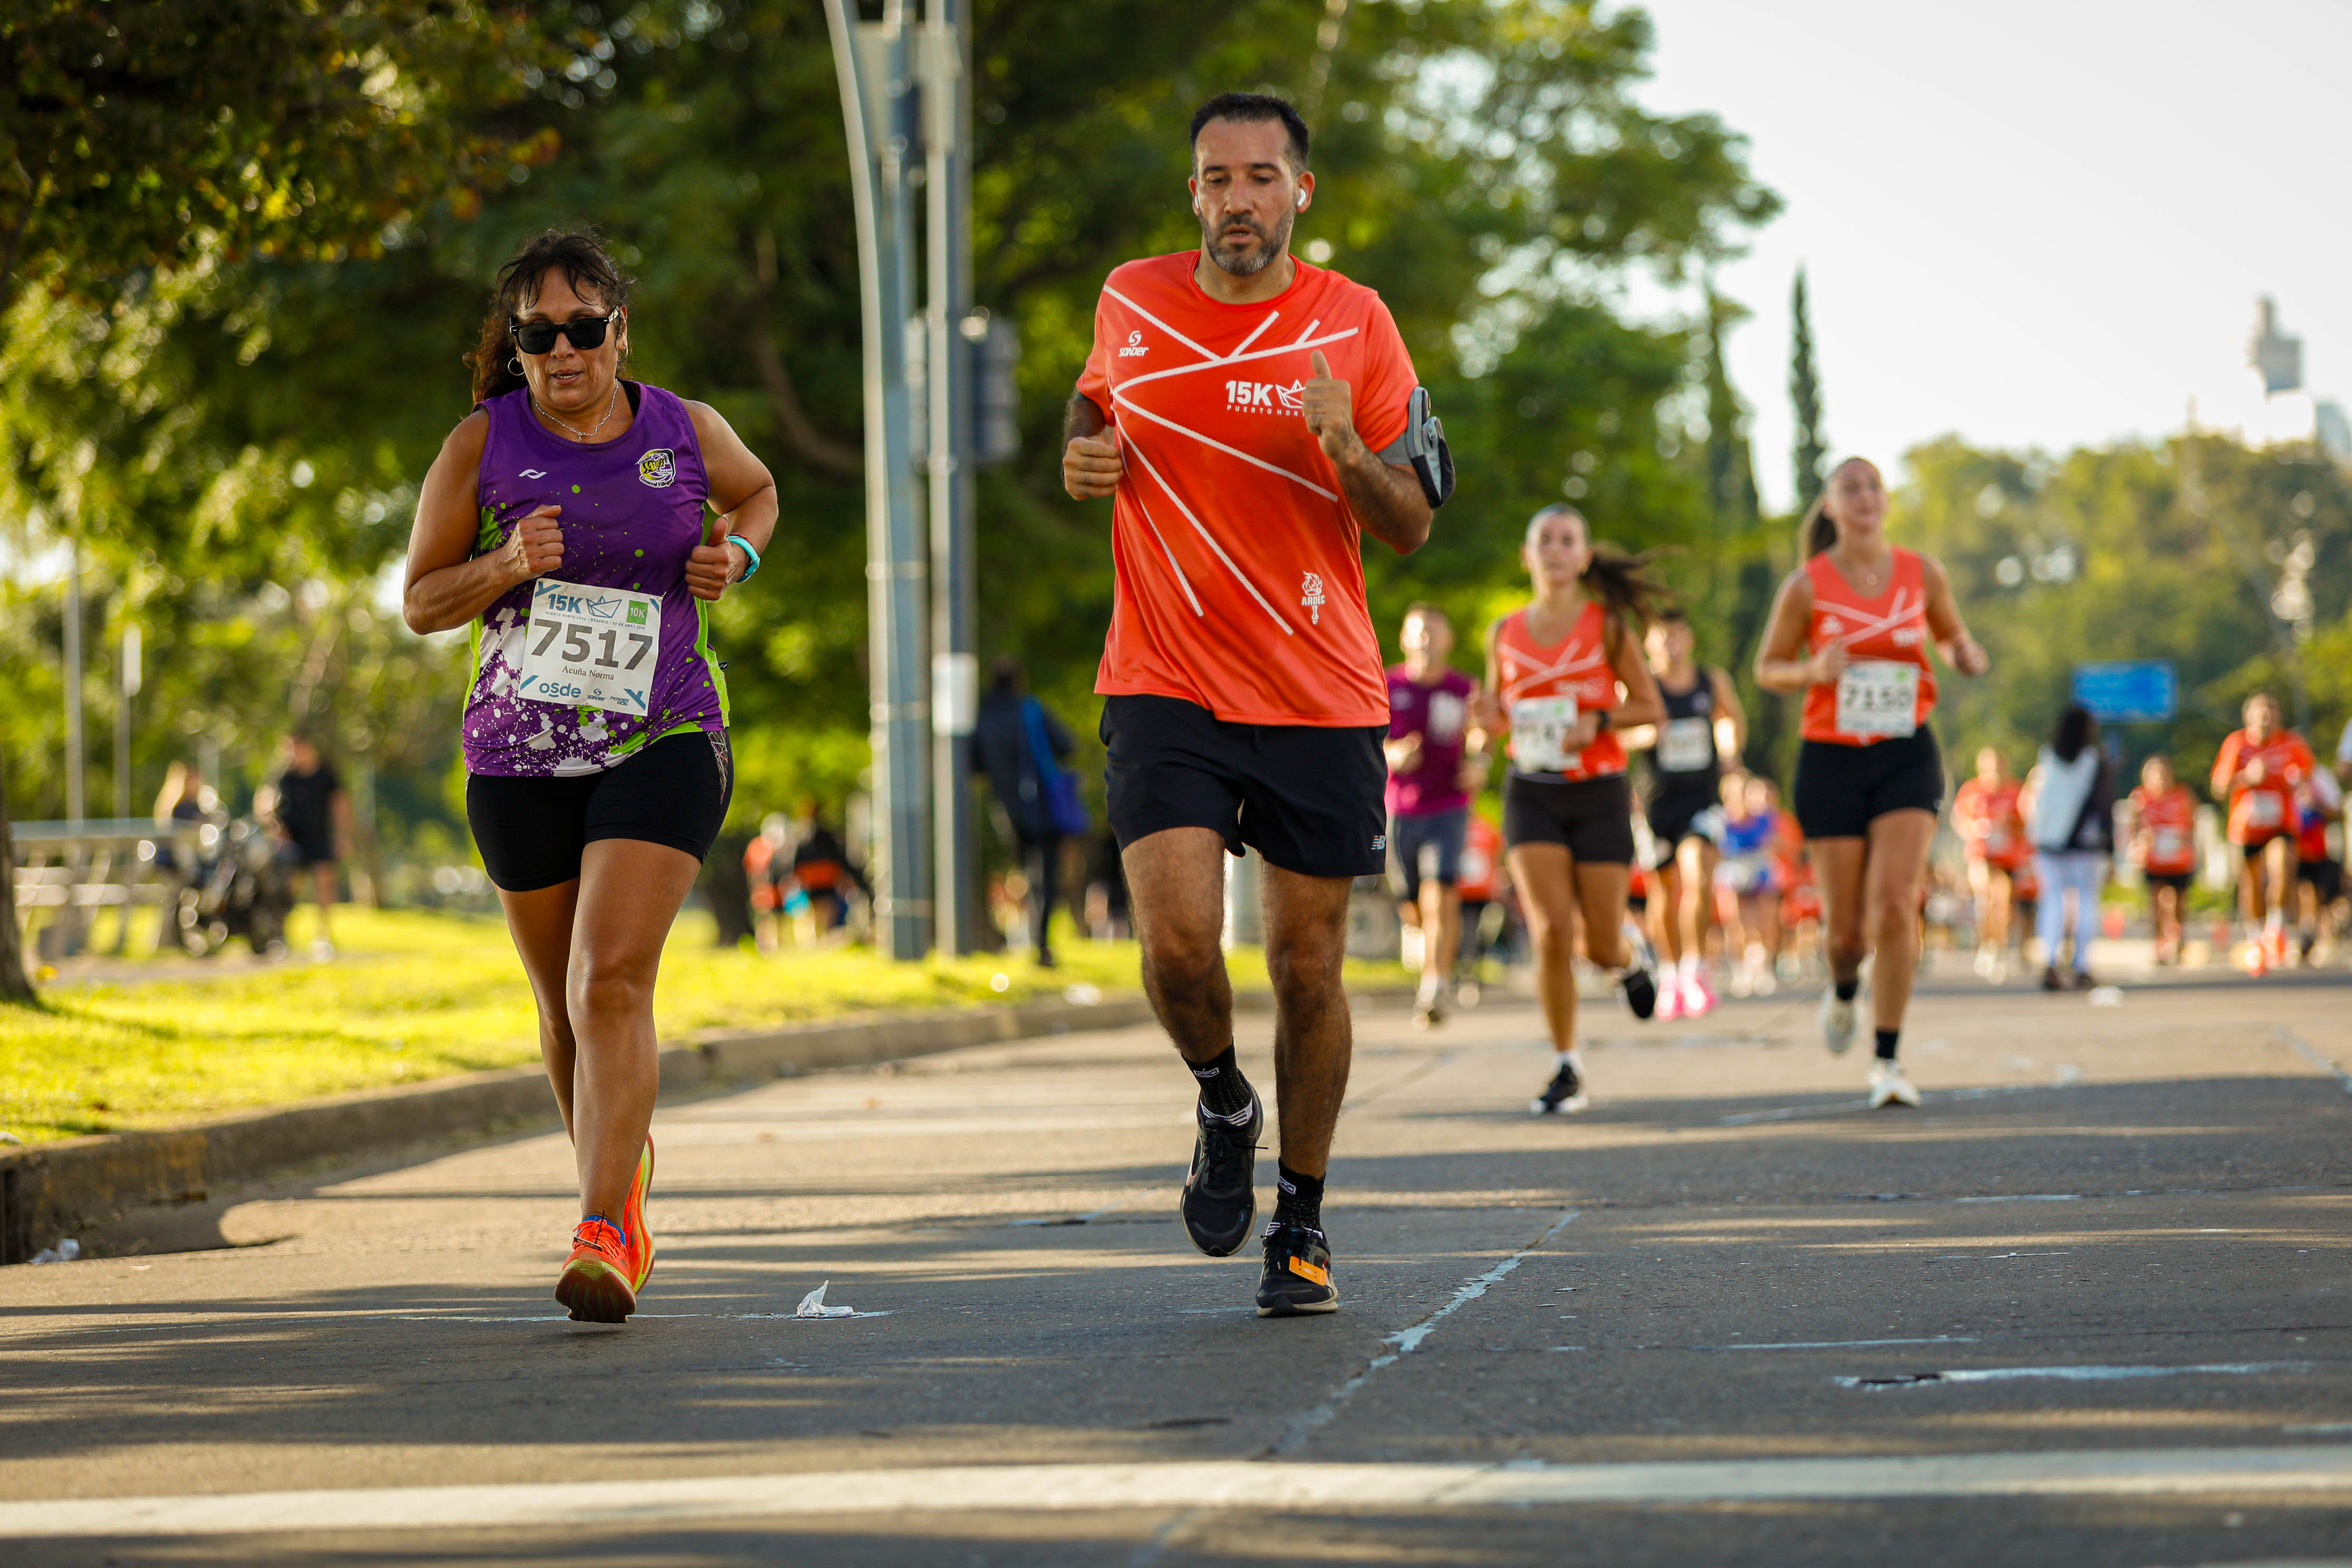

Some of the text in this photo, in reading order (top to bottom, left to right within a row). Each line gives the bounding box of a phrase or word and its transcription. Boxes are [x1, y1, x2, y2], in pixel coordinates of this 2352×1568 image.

[1226, 380, 1273, 406] 15K
[640, 476, 658, 486] General
[547, 593, 583, 614] 15K
[1301, 595, 1325, 606] ARDEC
[630, 607, 645, 618] 10K
[531, 618, 653, 670] 7517
[562, 665, 614, 680] Acuña Norma
[539, 682, 582, 698] osde
